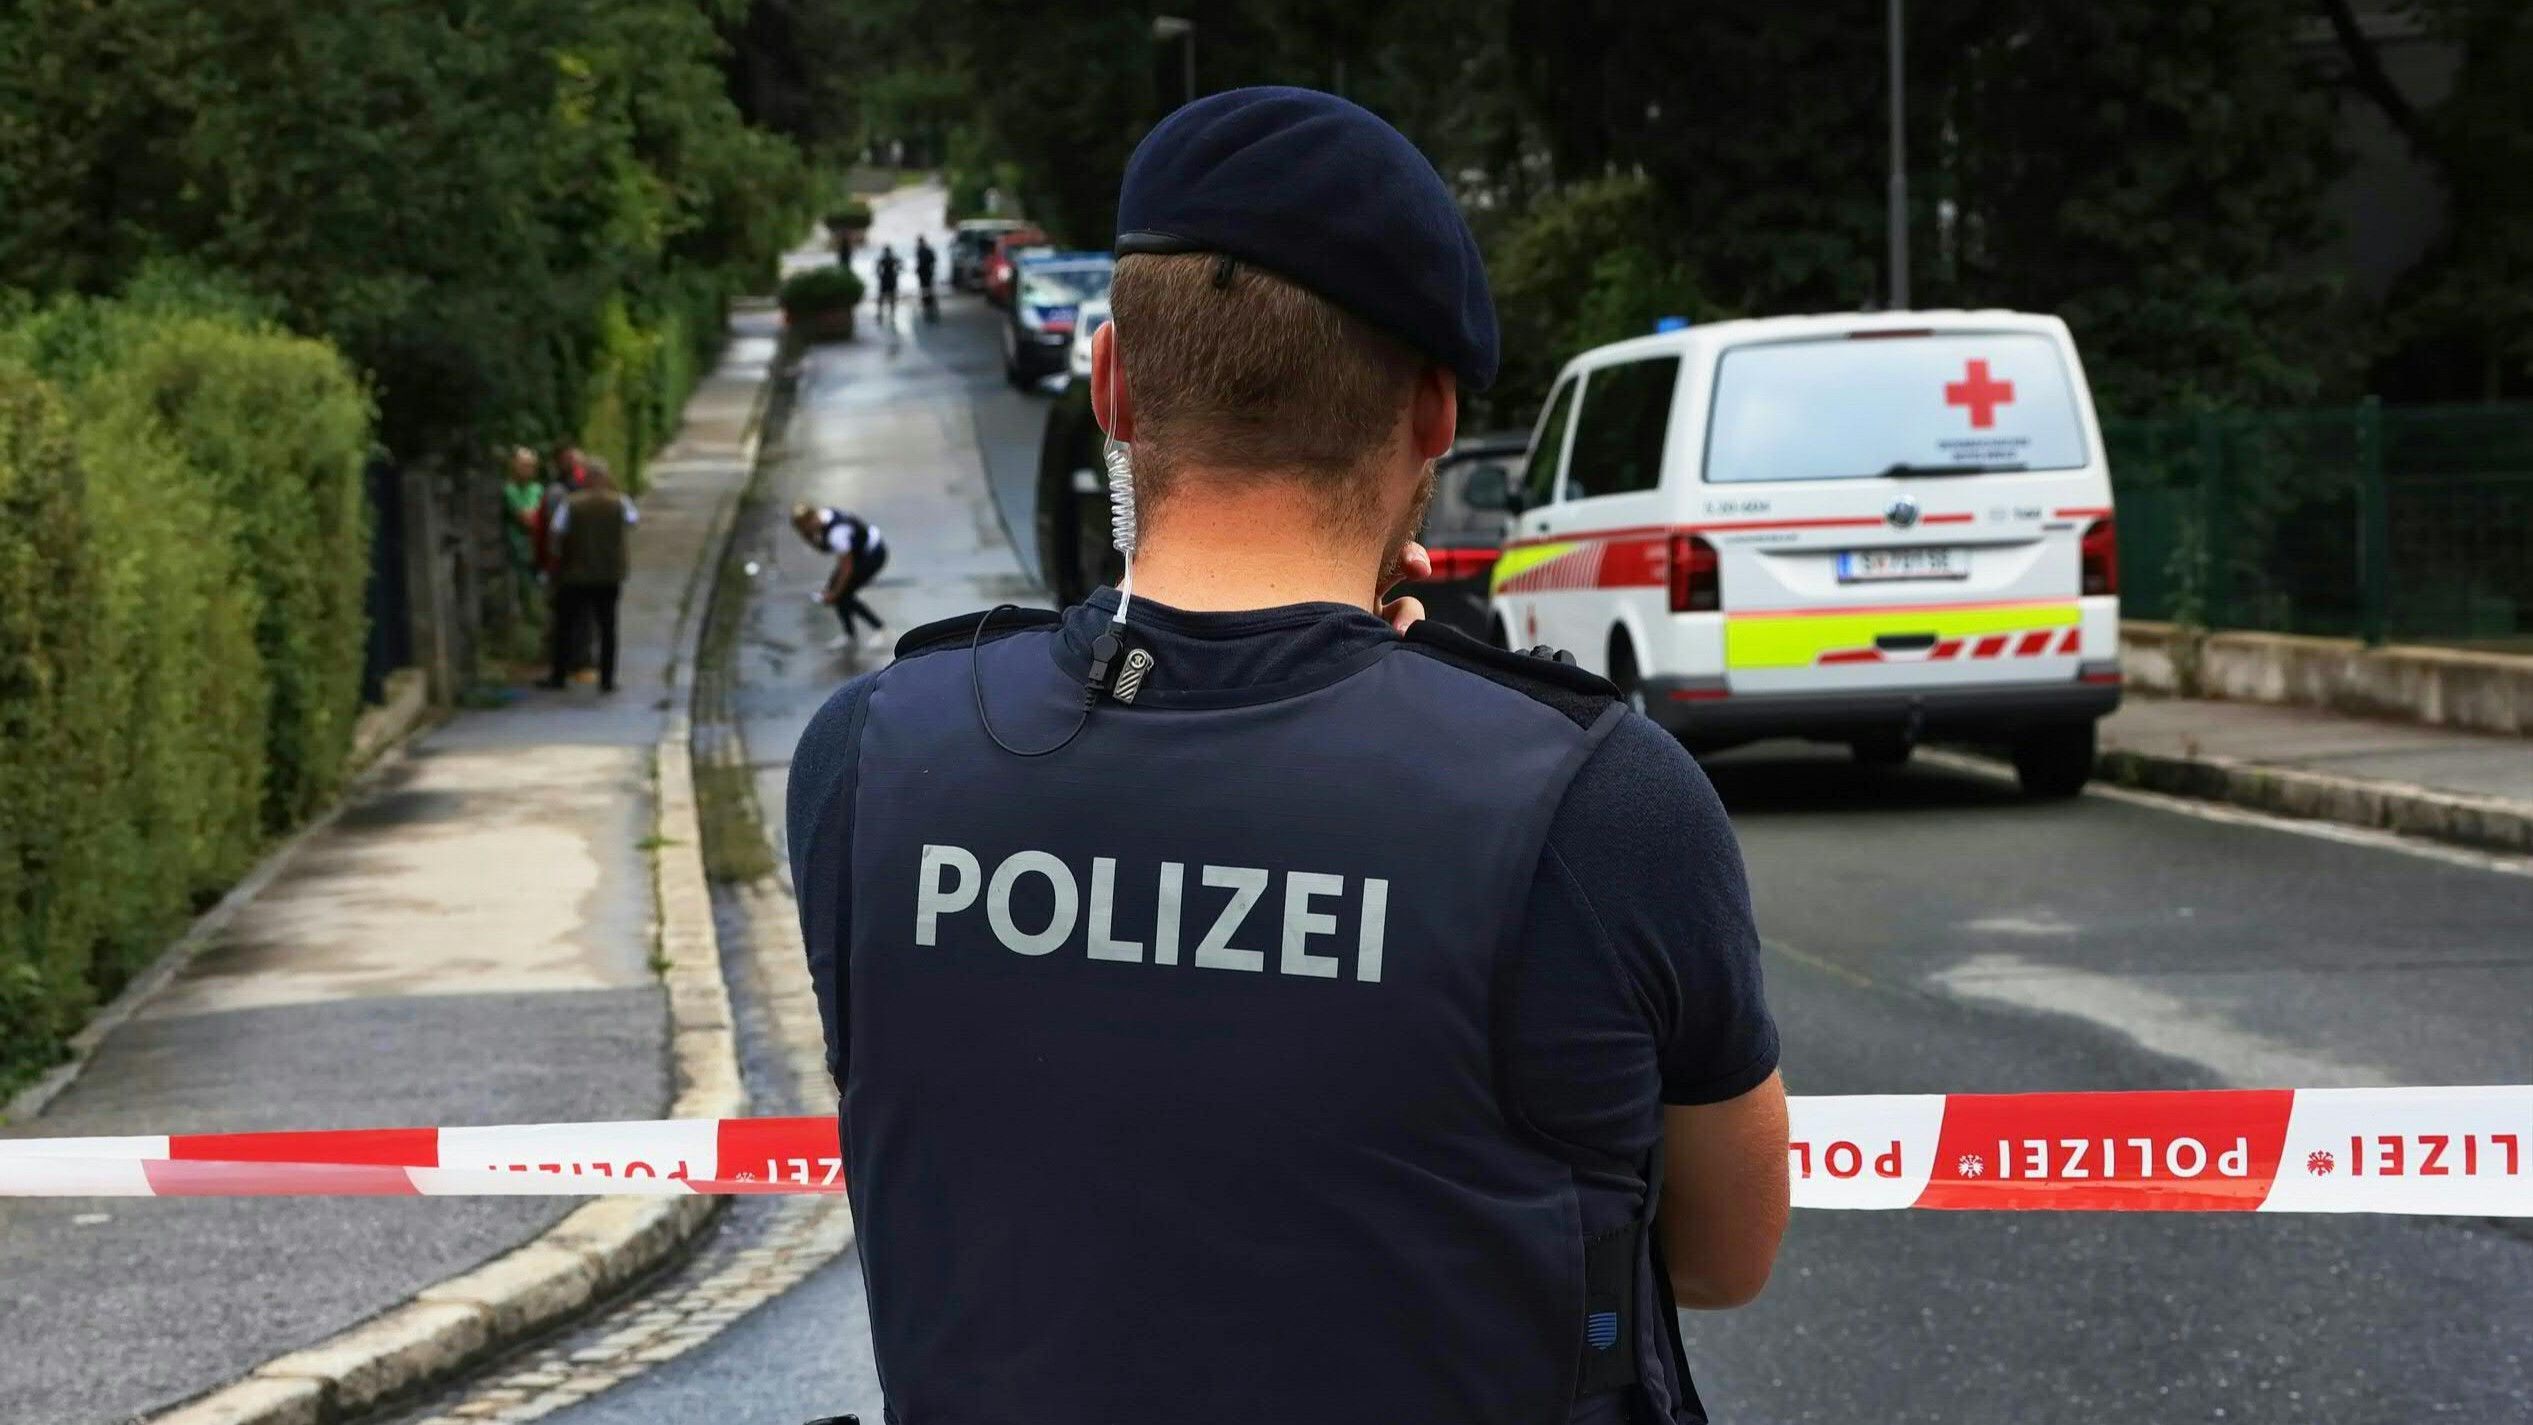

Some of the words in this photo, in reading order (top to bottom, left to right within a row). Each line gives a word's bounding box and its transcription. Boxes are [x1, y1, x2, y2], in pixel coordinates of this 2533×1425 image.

[915, 843, 1389, 983] POLIZEI
[1999, 1137, 2248, 1179] POLIZEI
[2351, 1134, 2519, 1177] LIZEI
